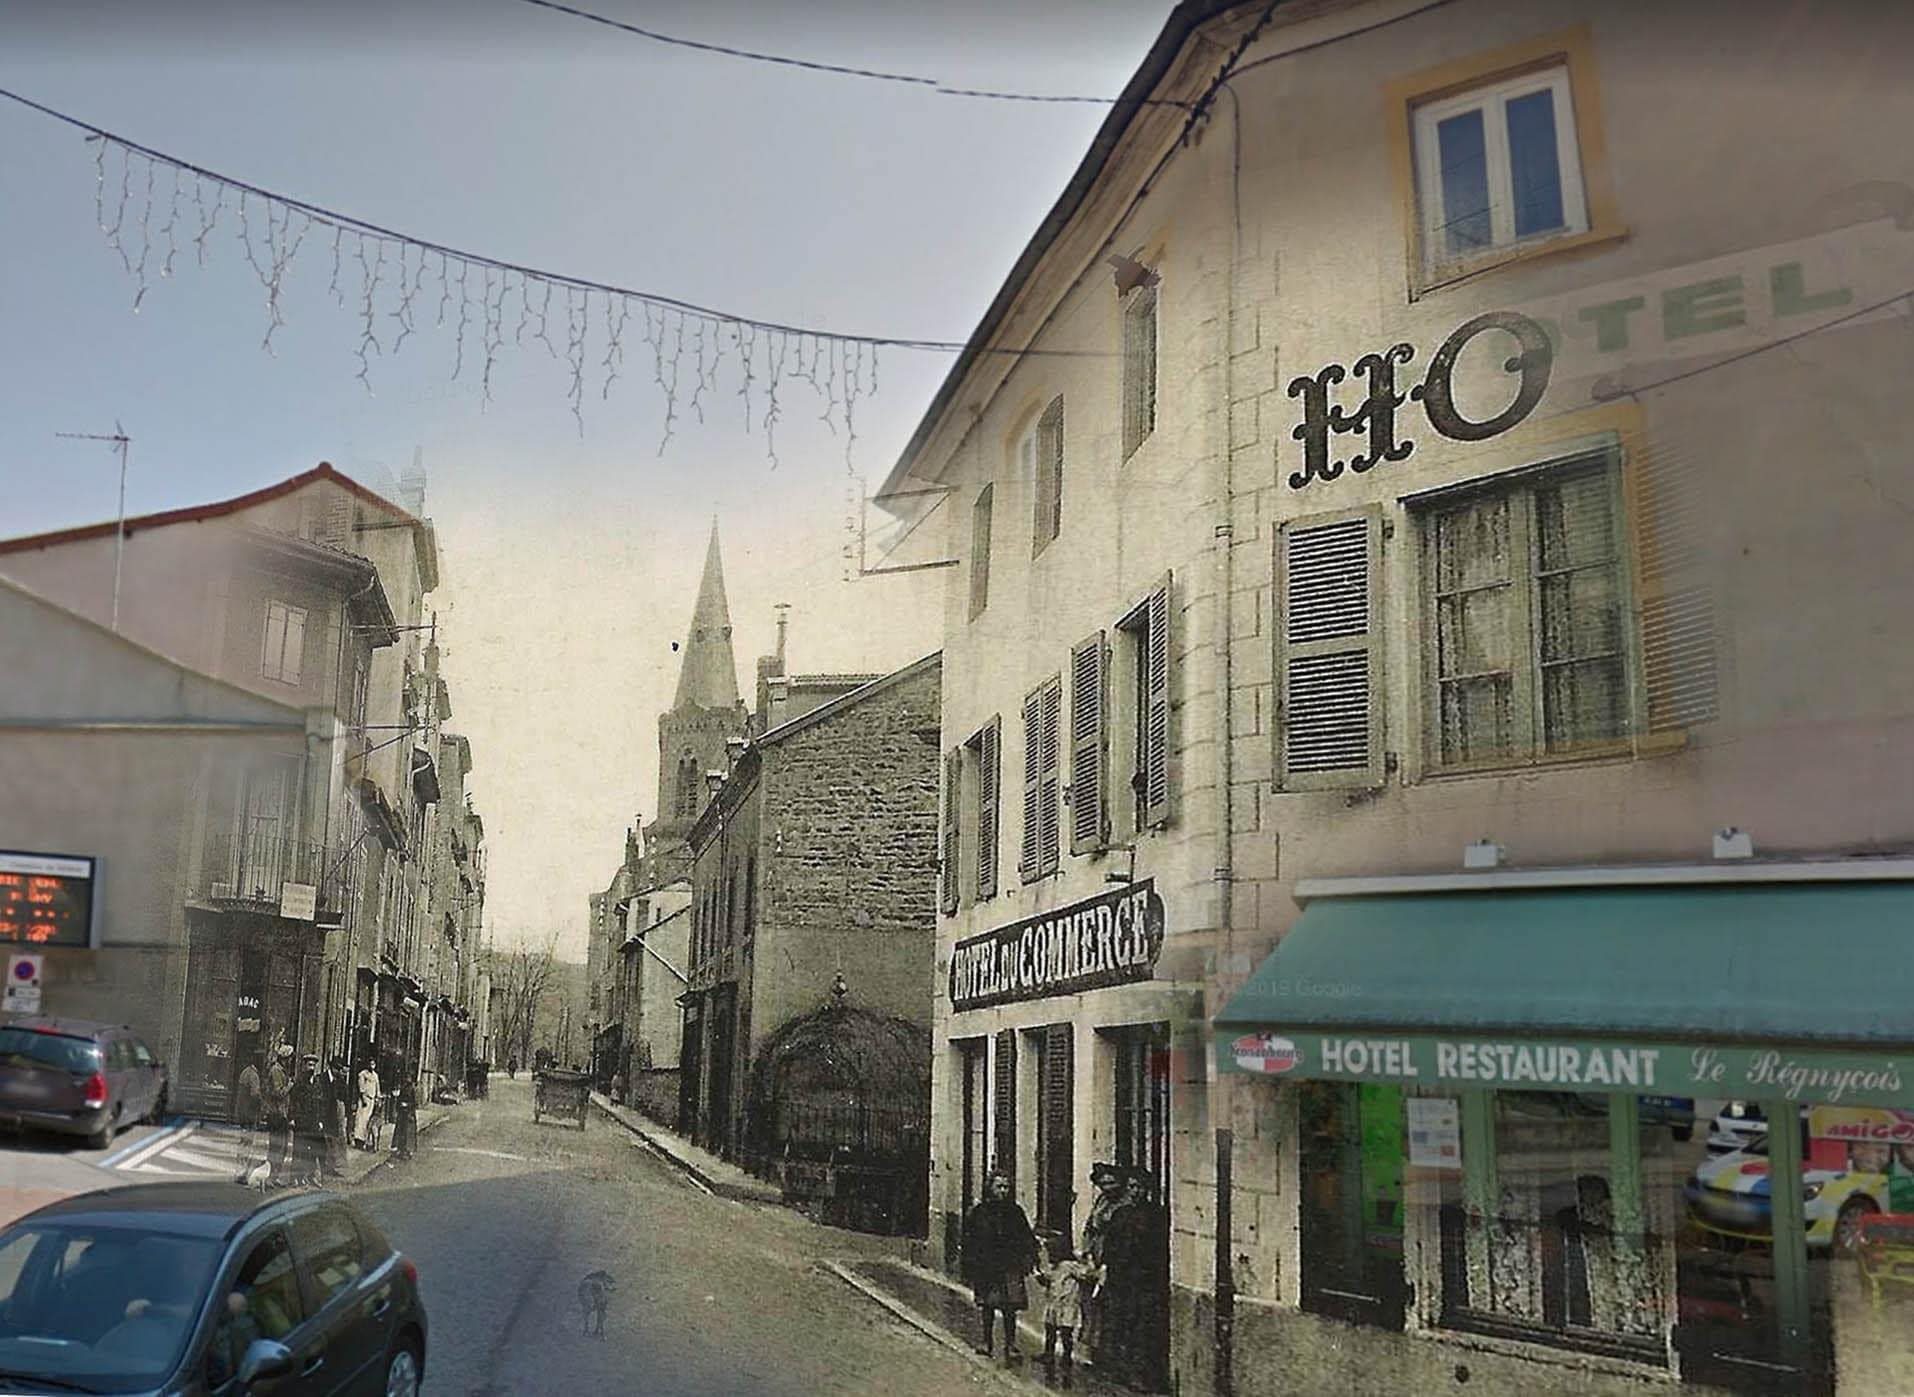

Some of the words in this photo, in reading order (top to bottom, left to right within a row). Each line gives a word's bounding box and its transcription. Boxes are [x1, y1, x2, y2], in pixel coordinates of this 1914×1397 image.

[954, 938, 1000, 1001] HOTEL
[1020, 889, 1149, 988] COMMERCE
[1320, 1038, 1418, 1077] HOTEL
[1436, 1041, 1661, 1087] RESTAURANT
[1688, 1044, 1727, 1083] Le
[1746, 1048, 1902, 1103] Régnycois
